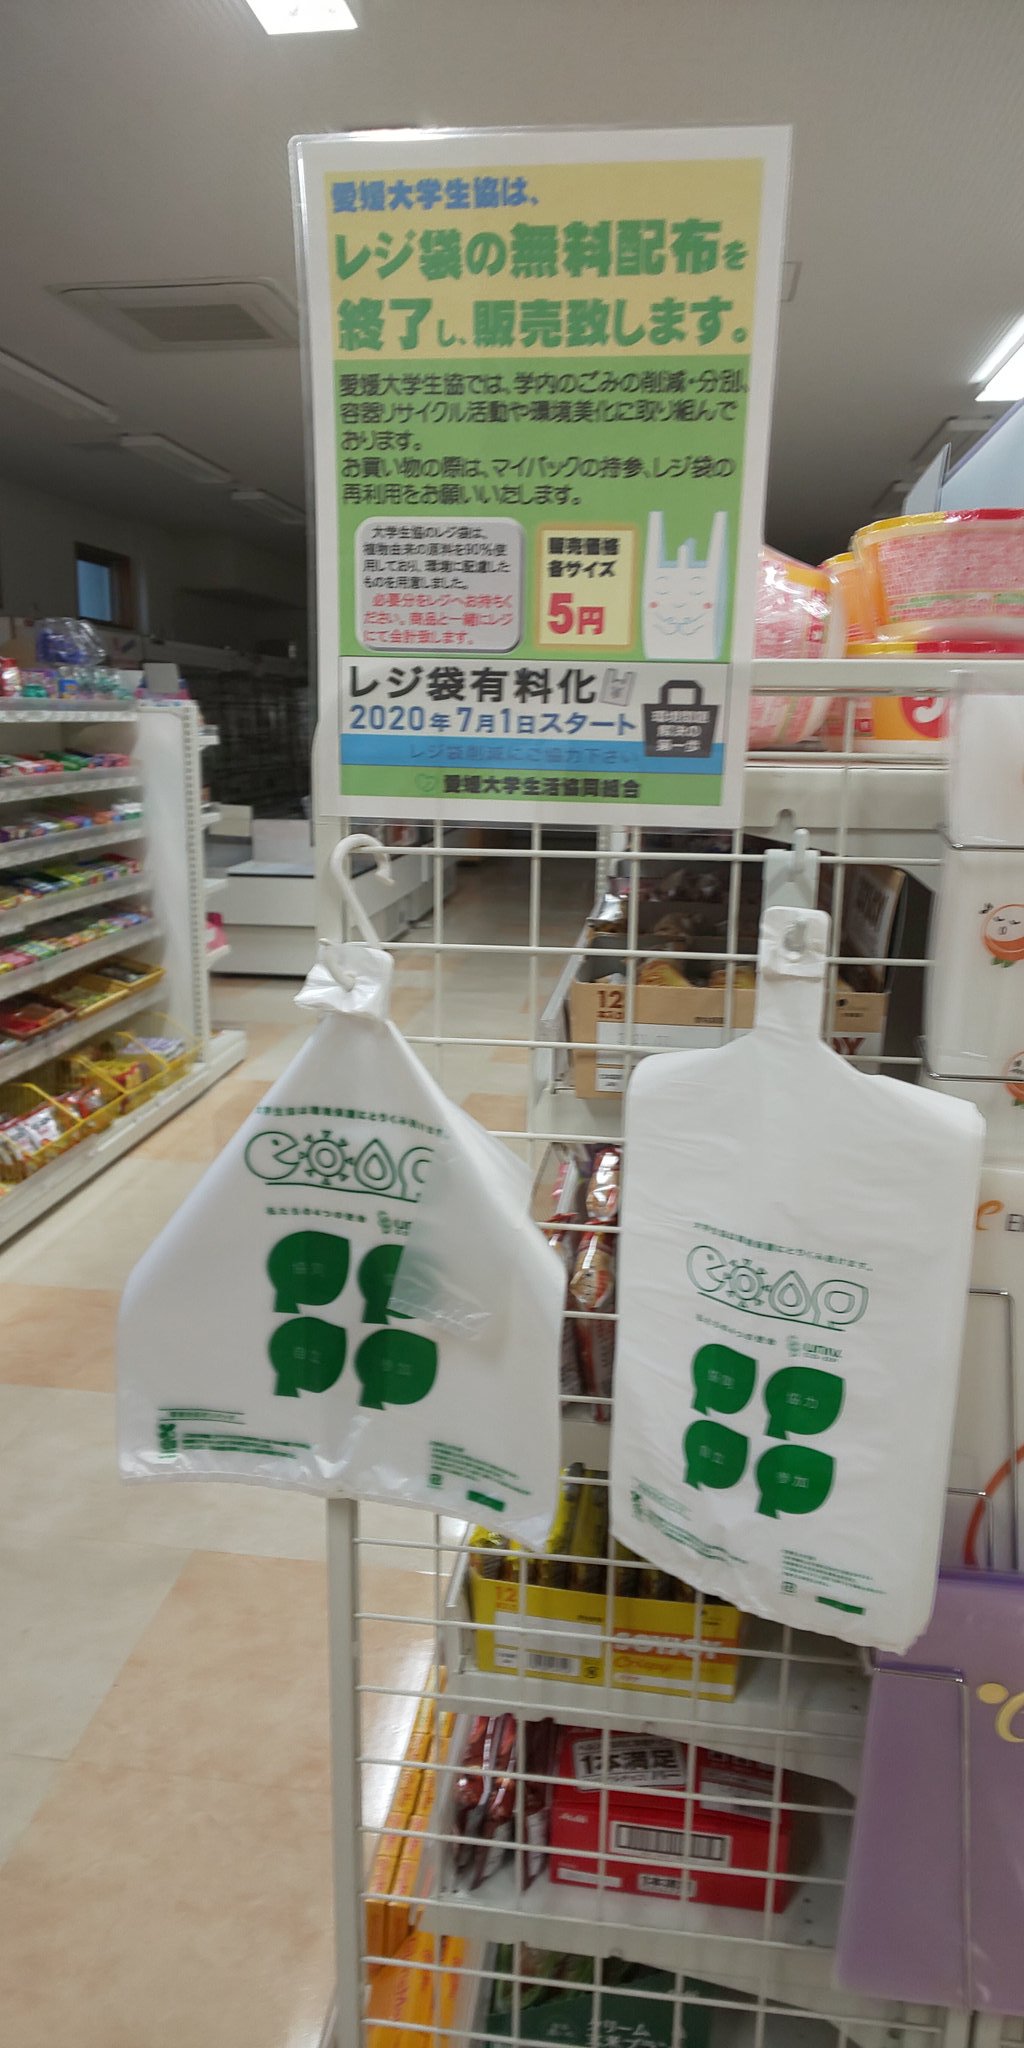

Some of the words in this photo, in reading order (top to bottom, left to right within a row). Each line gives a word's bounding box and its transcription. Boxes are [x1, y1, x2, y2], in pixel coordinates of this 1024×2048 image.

[332, 176, 539, 213] 愛媛大学生協は、
[334, 218, 748, 281] レジ袋の無料配布を
[338, 295, 749, 352] 終了し、販売致します。
[341, 431, 422, 451] おります。
[343, 483, 582, 505] 再利用をお願いいたします。
[548, 537, 621, 557] 販売価格
[548, 559, 616, 579] 各サイズ
[548, 592, 605, 636] 5円
[350, 665, 597, 704] レジ袋有料化
[349, 703, 637, 737] 2020年7月1日スタート
[443, 773, 641, 799] 愛媛大学生活協同組合
